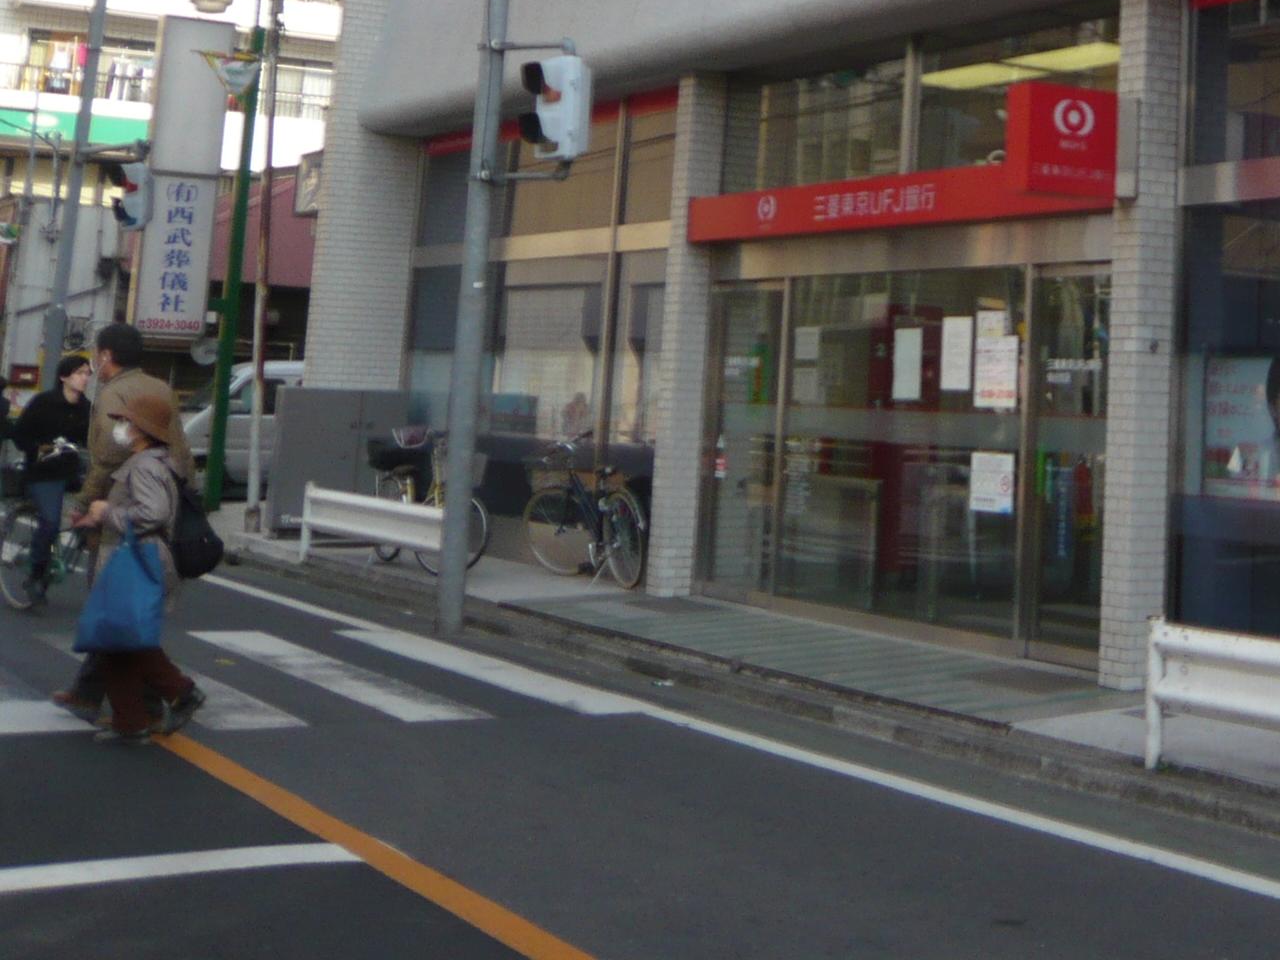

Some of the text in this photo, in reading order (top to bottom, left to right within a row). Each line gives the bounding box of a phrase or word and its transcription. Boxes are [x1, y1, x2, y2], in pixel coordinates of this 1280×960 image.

[814, 183, 936, 221] 三菱東京UFJ銀行
